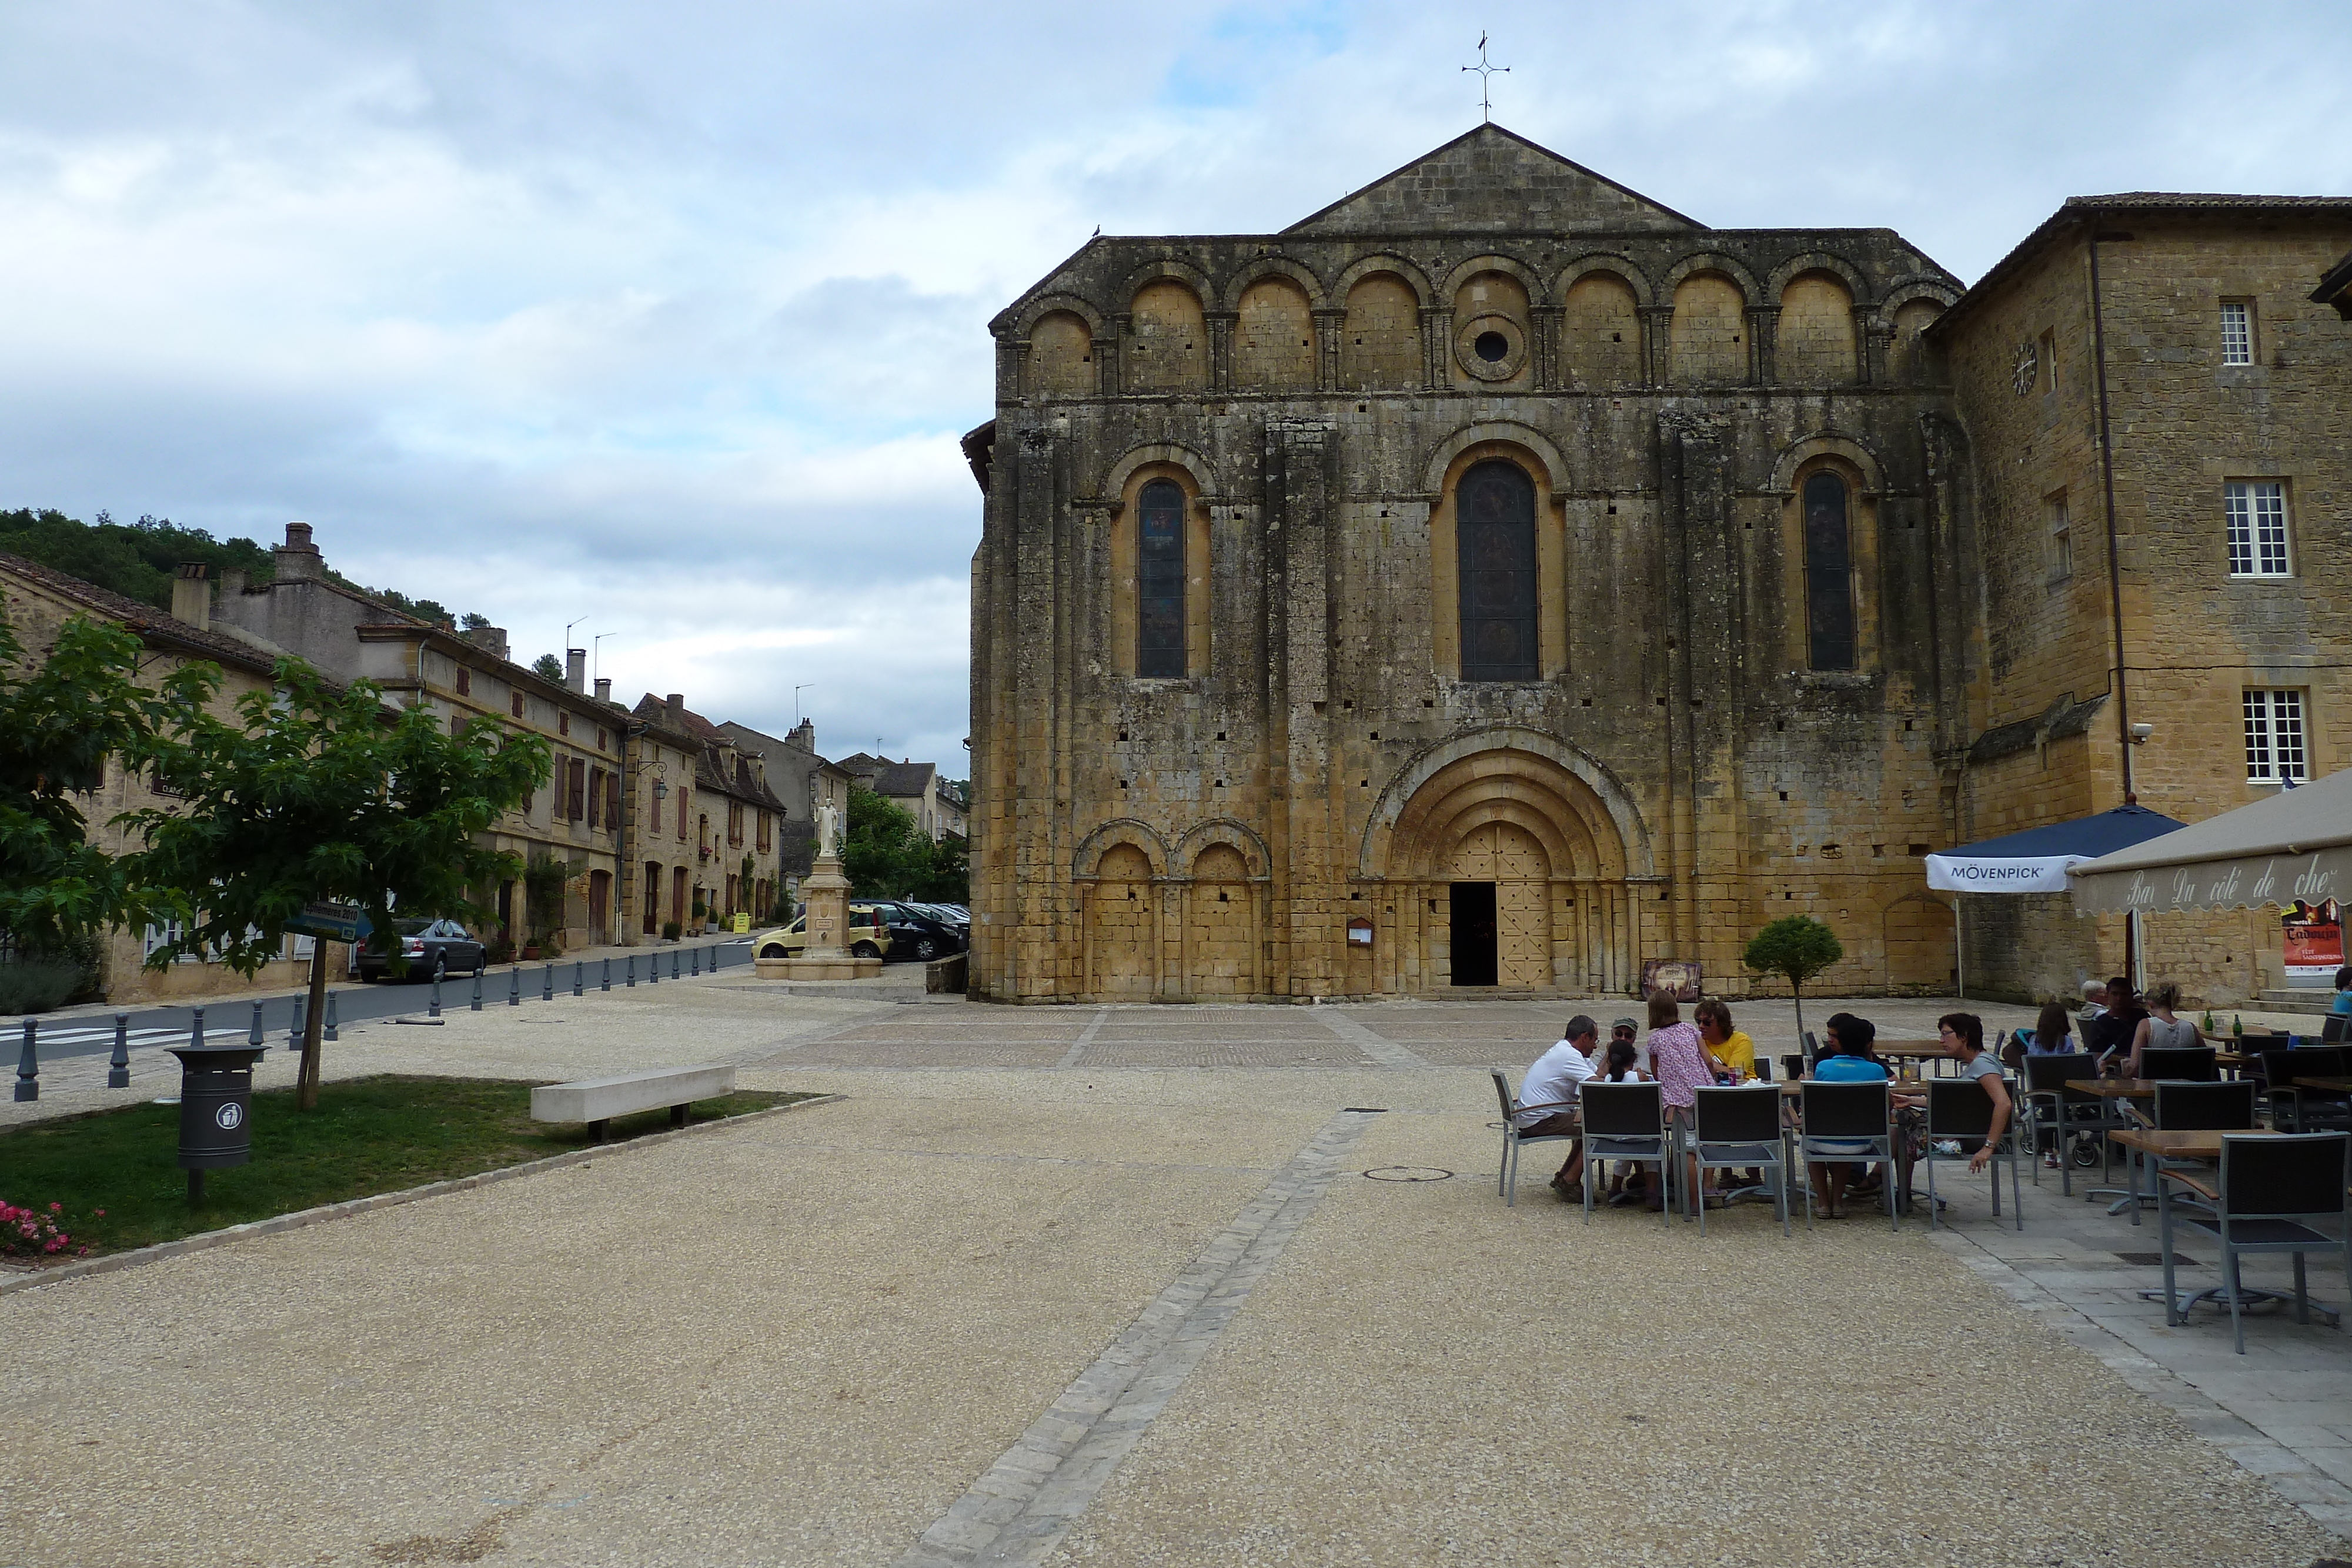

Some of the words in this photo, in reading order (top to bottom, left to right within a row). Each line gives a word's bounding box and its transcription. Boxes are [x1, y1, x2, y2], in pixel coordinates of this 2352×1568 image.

[2127, 870, 2154, 905] Bar
[2171, 868, 2196, 903] Du
[2253, 860, 2274, 897] de
[342, 908, 358, 921] 2010
